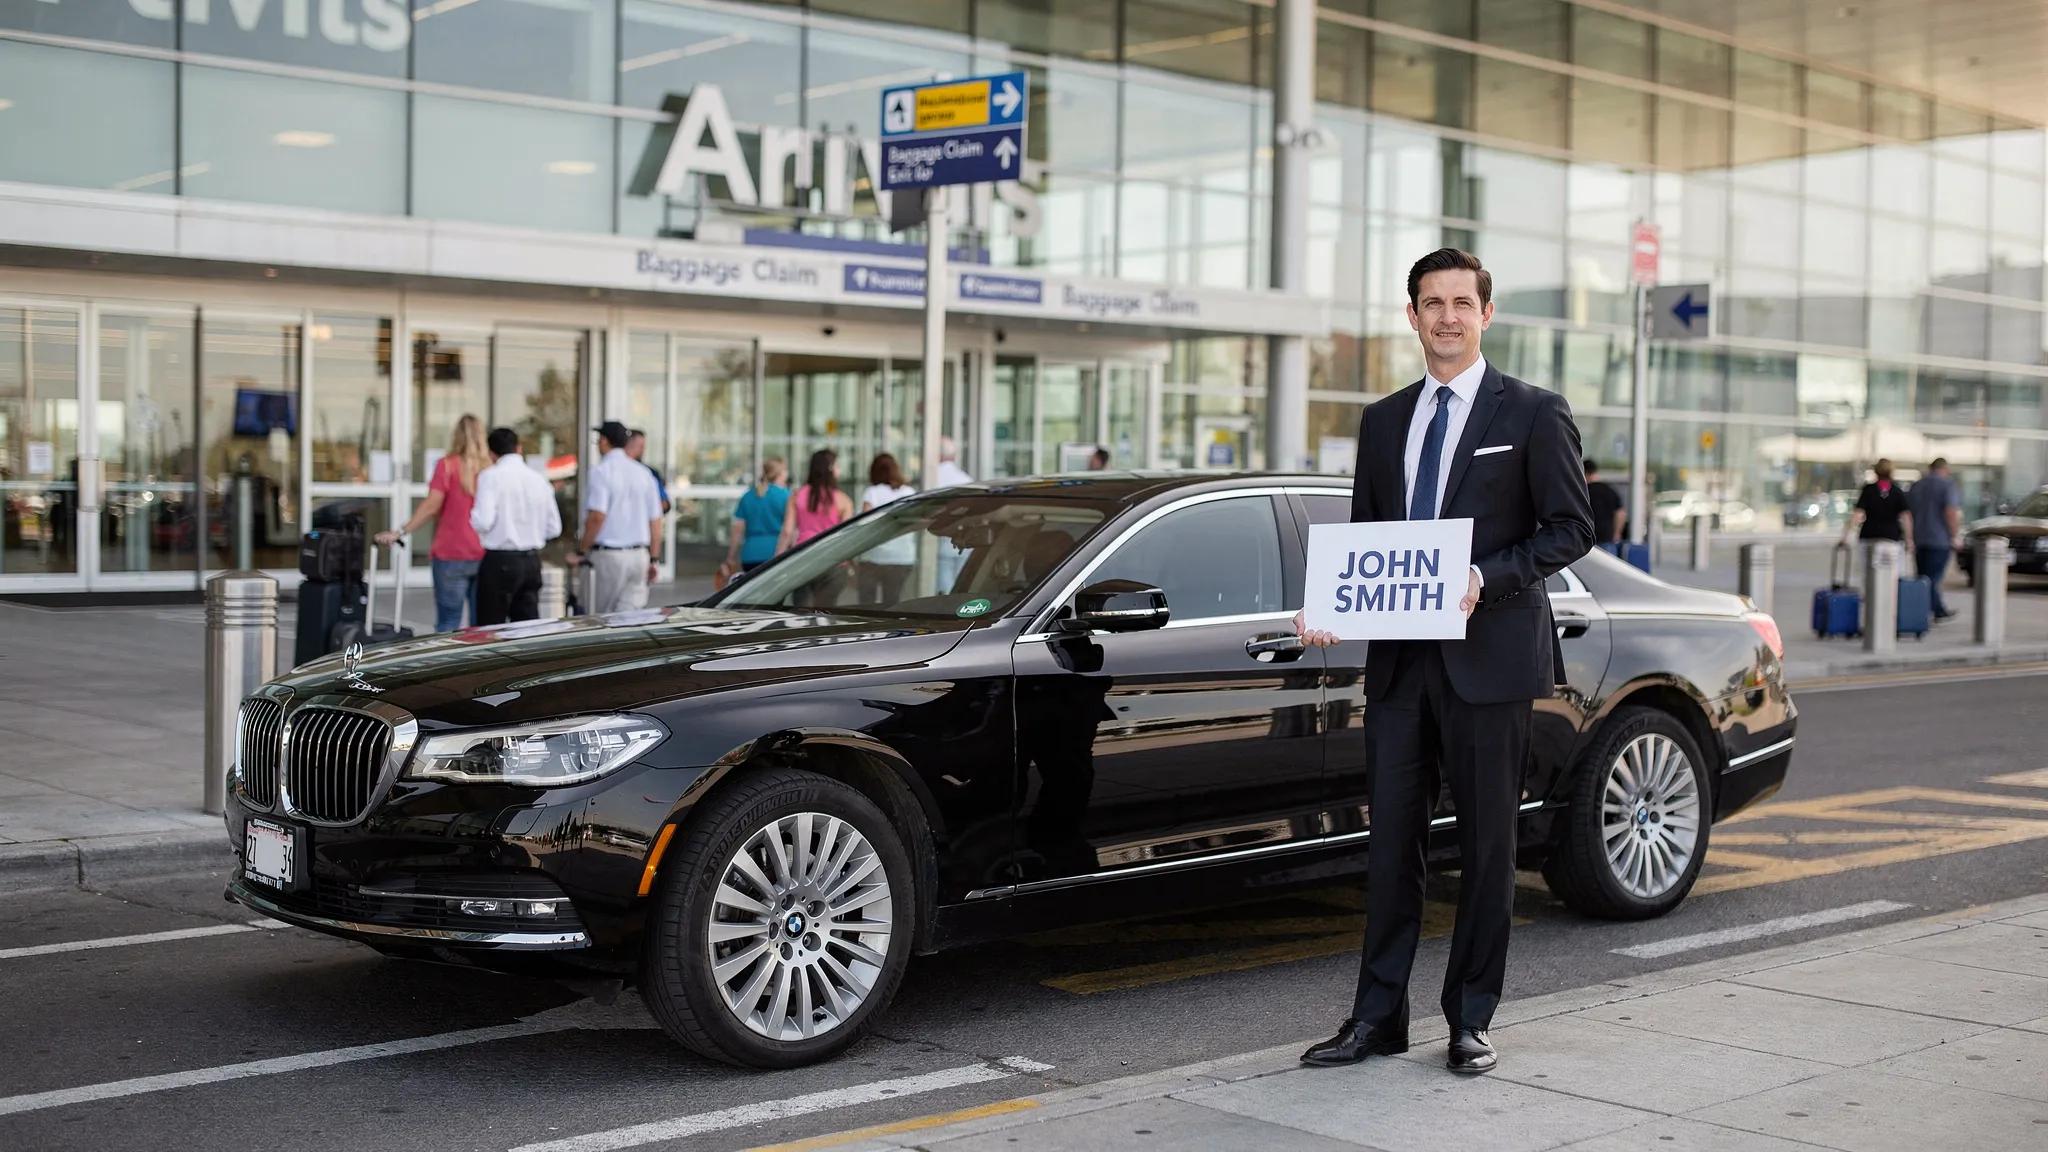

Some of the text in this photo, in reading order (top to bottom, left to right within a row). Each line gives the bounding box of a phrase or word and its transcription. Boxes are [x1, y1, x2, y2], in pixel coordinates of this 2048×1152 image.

[637, 250, 820, 286] Baggage Claim
[1338, 549, 1440, 580] JOHN
[1334, 582, 1445, 613] SMITH
